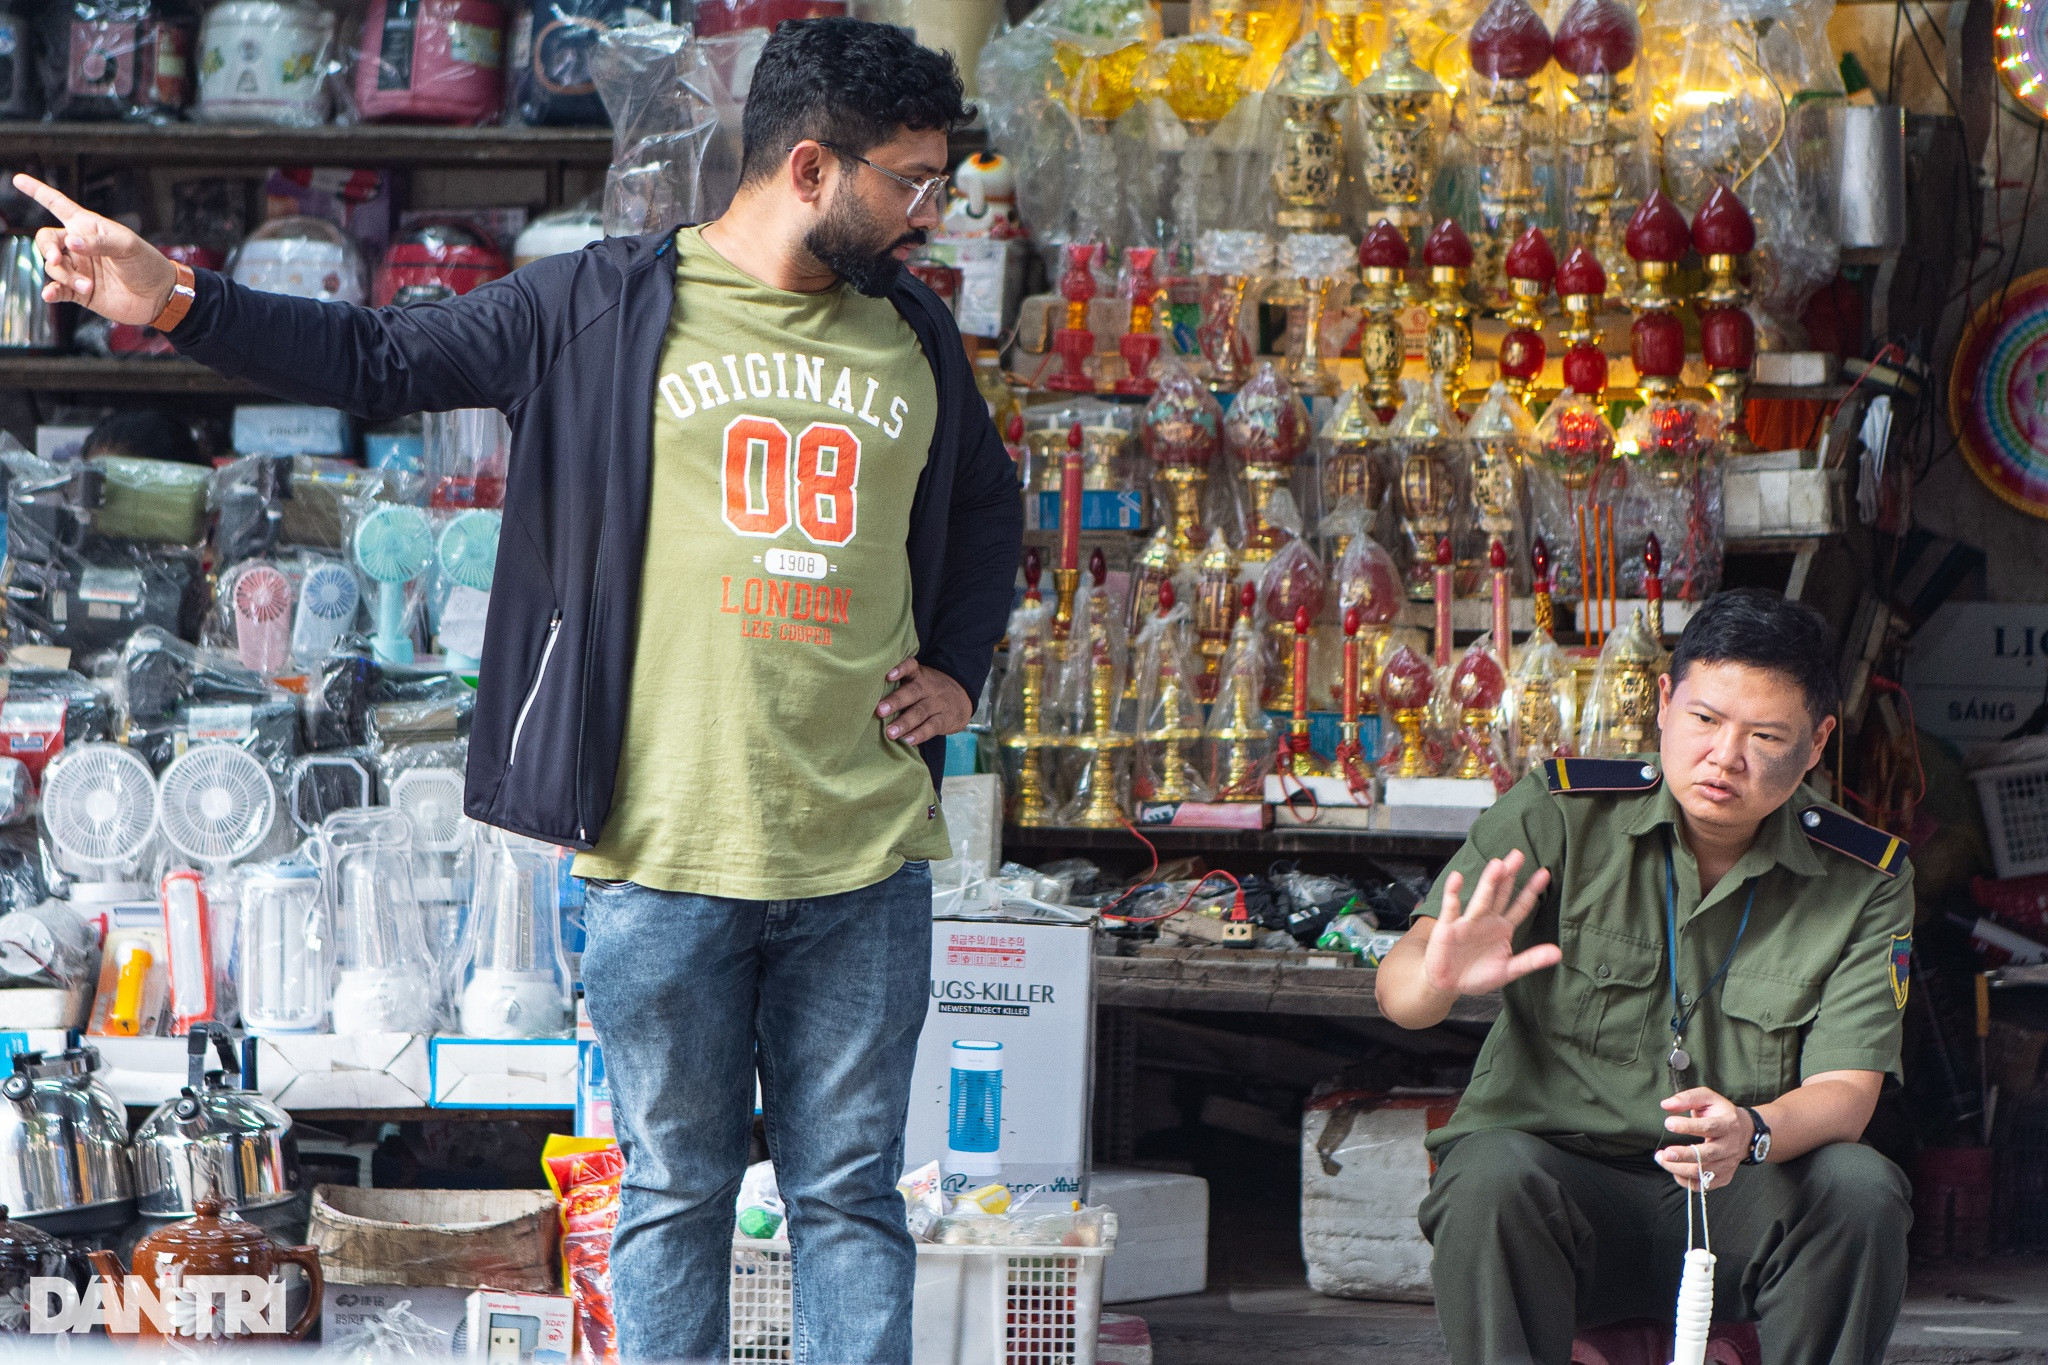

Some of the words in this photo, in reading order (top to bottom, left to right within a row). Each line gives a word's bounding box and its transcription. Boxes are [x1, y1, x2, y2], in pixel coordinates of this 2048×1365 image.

[659, 352, 909, 439] ORIGINALS
[721, 413, 862, 548] 08
[779, 553, 815, 574] 1908
[720, 576, 853, 625] LONDON
[741, 619, 773, 640] LEE
[779, 623, 832, 646] COOPER
[1995, 625, 2048, 667] LỊ
[1948, 697, 2017, 721] SÁNG
[950, 934, 1025, 947] 취급주의/파손주의
[941, 1004, 972, 1013] NEWEST
[974, 1006, 1001, 1014] INSECT
[1003, 1007, 1029, 1015] KILLER
